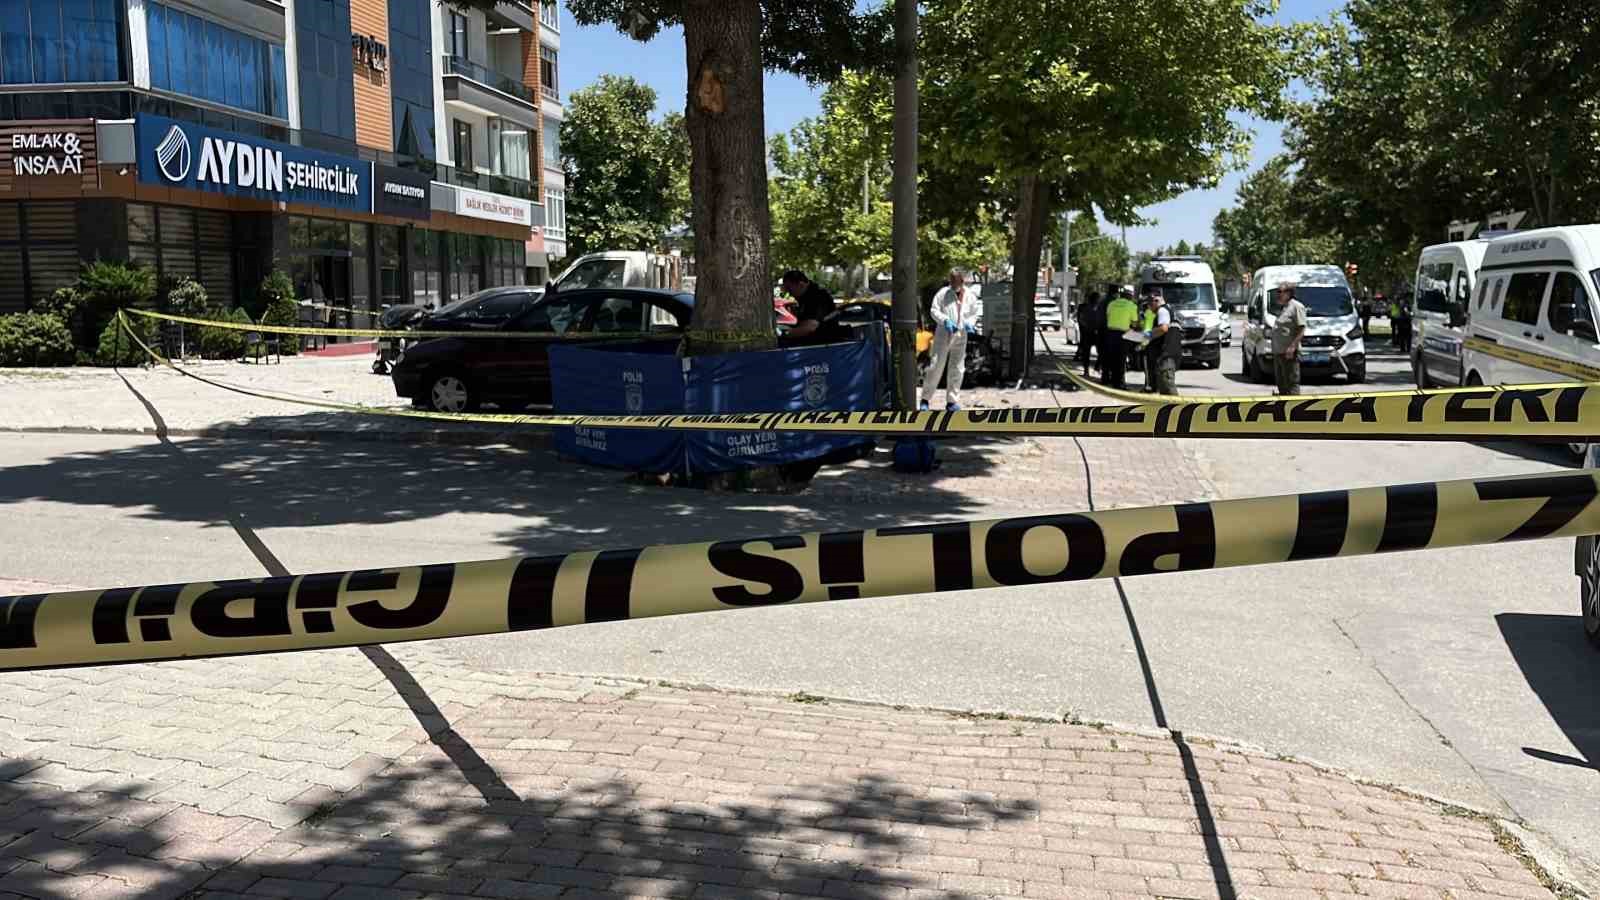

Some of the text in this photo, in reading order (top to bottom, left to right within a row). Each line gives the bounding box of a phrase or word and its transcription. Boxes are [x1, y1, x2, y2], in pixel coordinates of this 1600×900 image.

[12, 132, 82, 155] EMLAK &
[196, 136, 359, 196] AYDIN ŞEHİRCİLİK
[727, 432, 752, 446] OLAY
[710, 503, 1216, 606] POLİS
